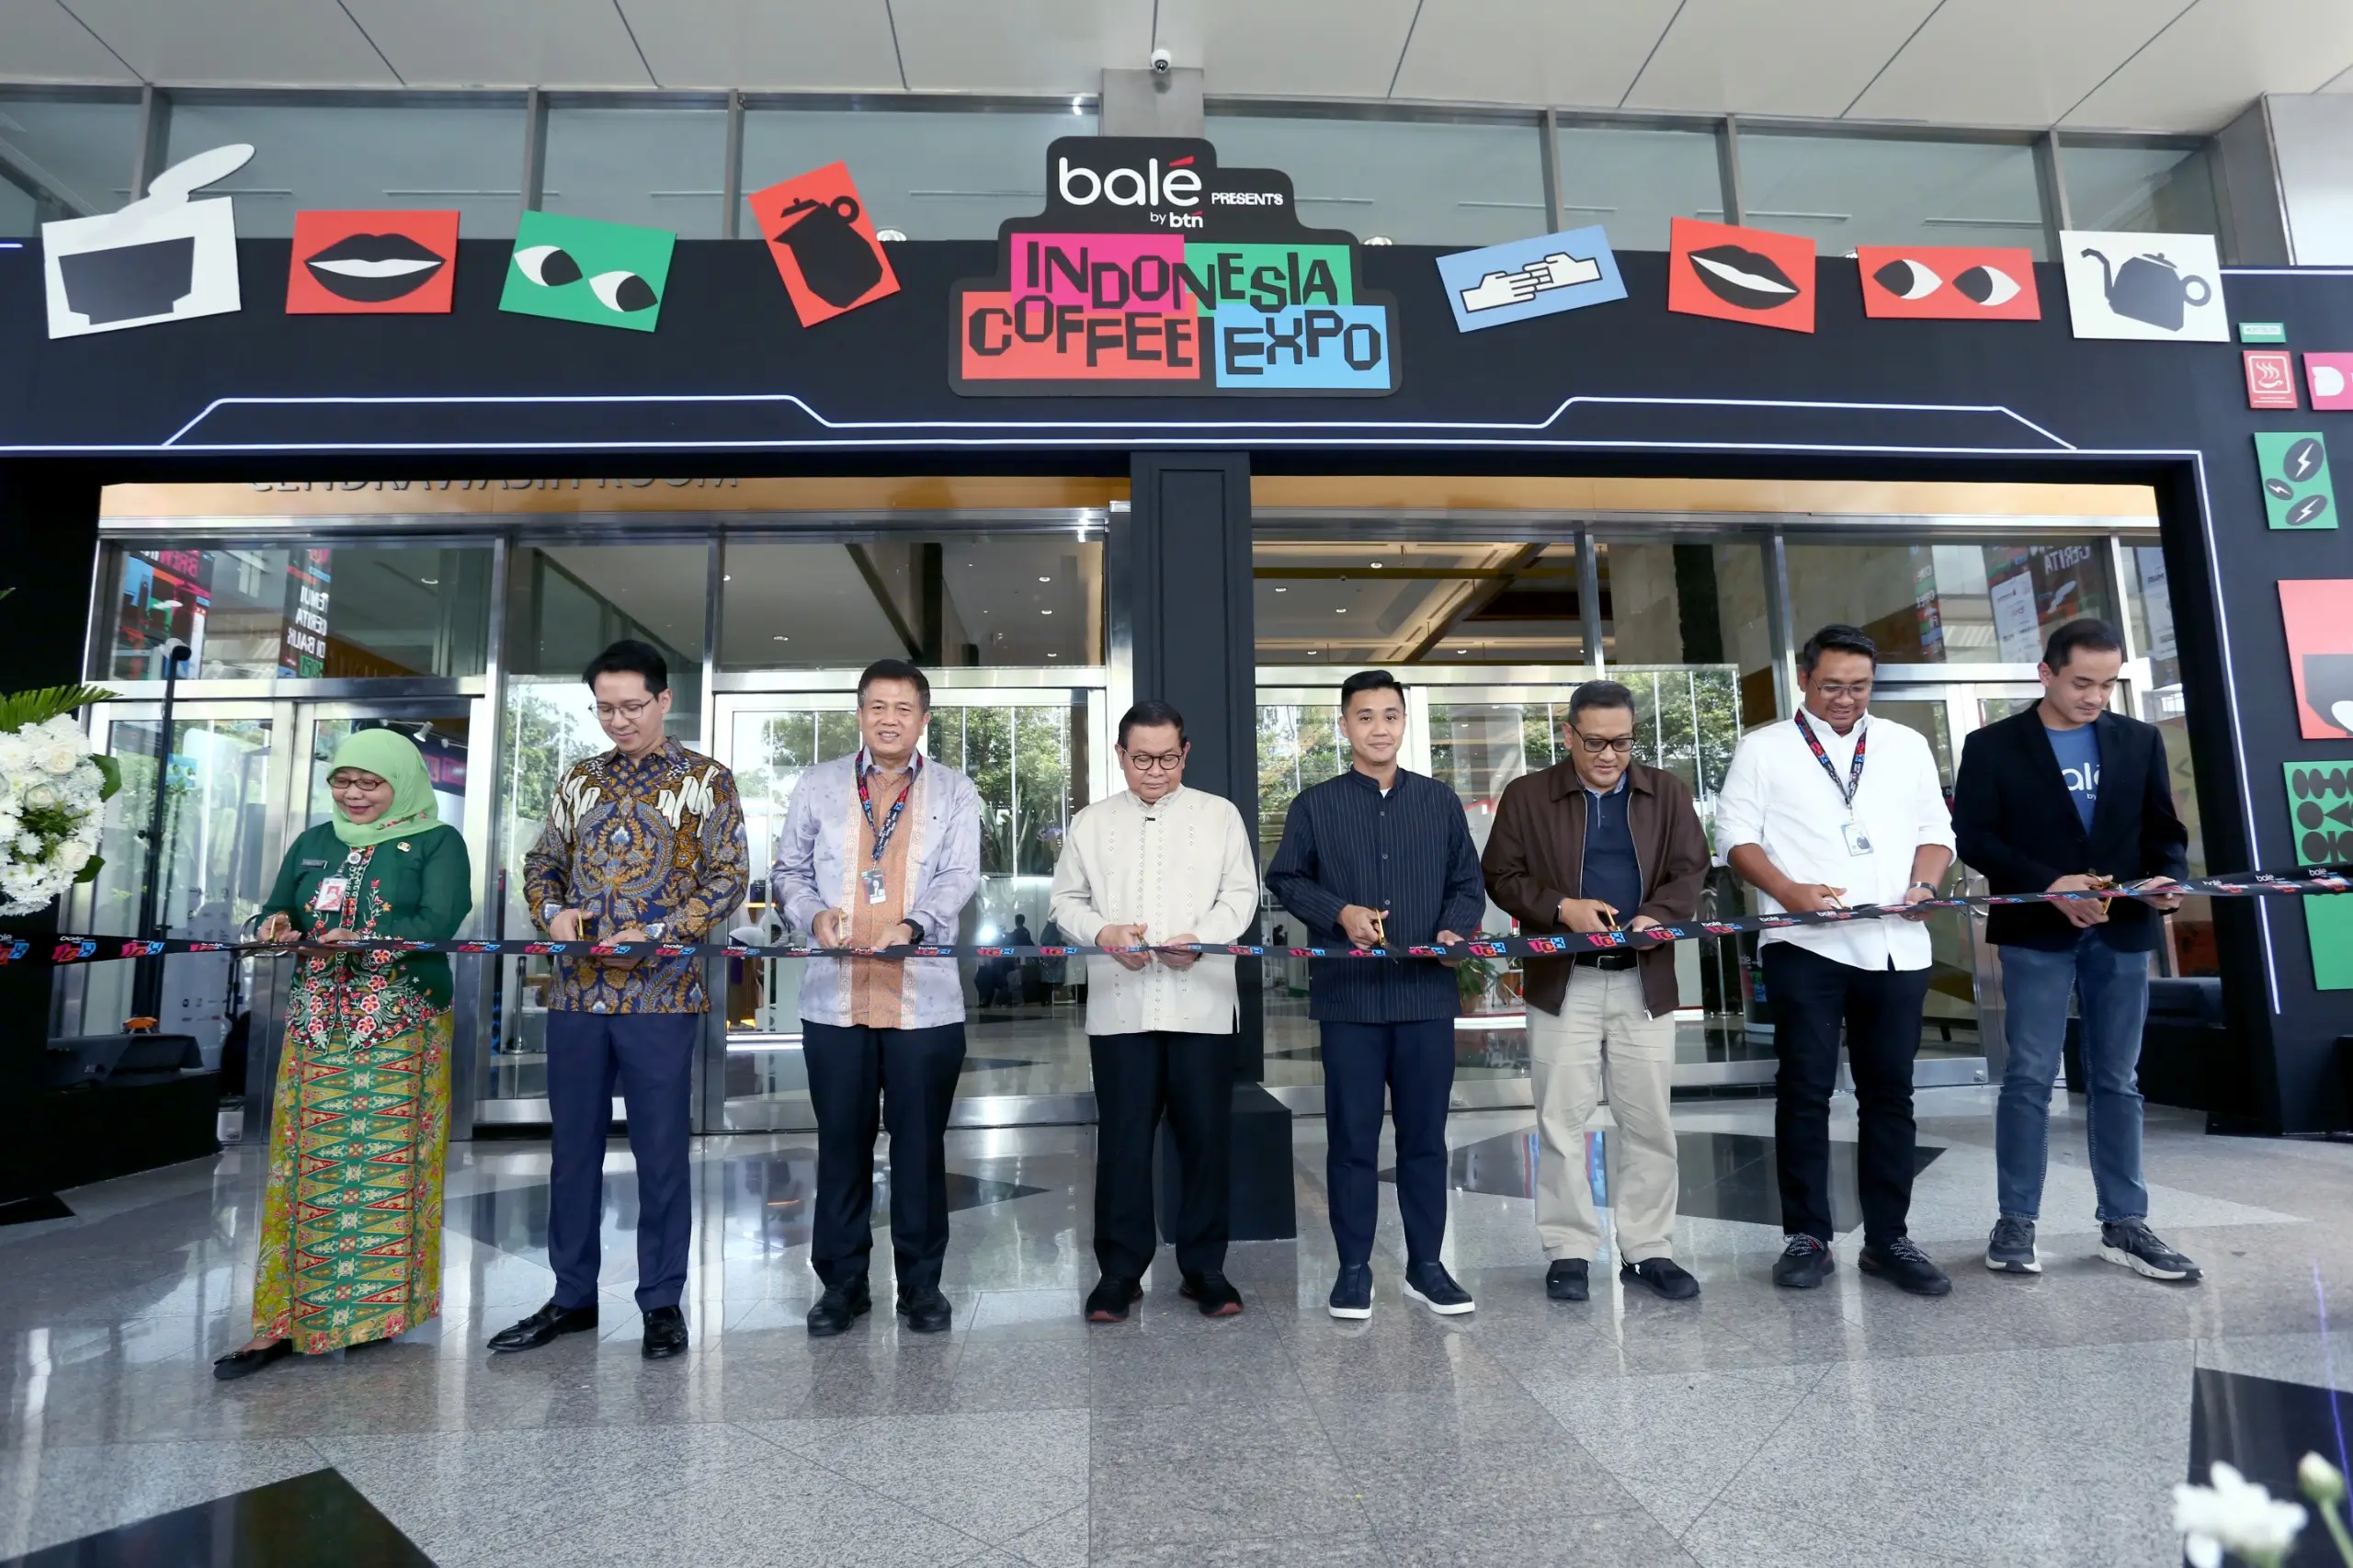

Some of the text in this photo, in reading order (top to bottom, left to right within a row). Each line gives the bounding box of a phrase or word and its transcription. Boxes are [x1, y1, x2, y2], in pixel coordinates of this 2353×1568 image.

[1059, 155, 1283, 206] balé PRESENTS
[1150, 211, 1166, 226] by
[1027, 241, 1338, 313] INDONESIA
[969, 295, 1381, 375] COFFEE EXPO
[2062, 762, 2100, 791] al
